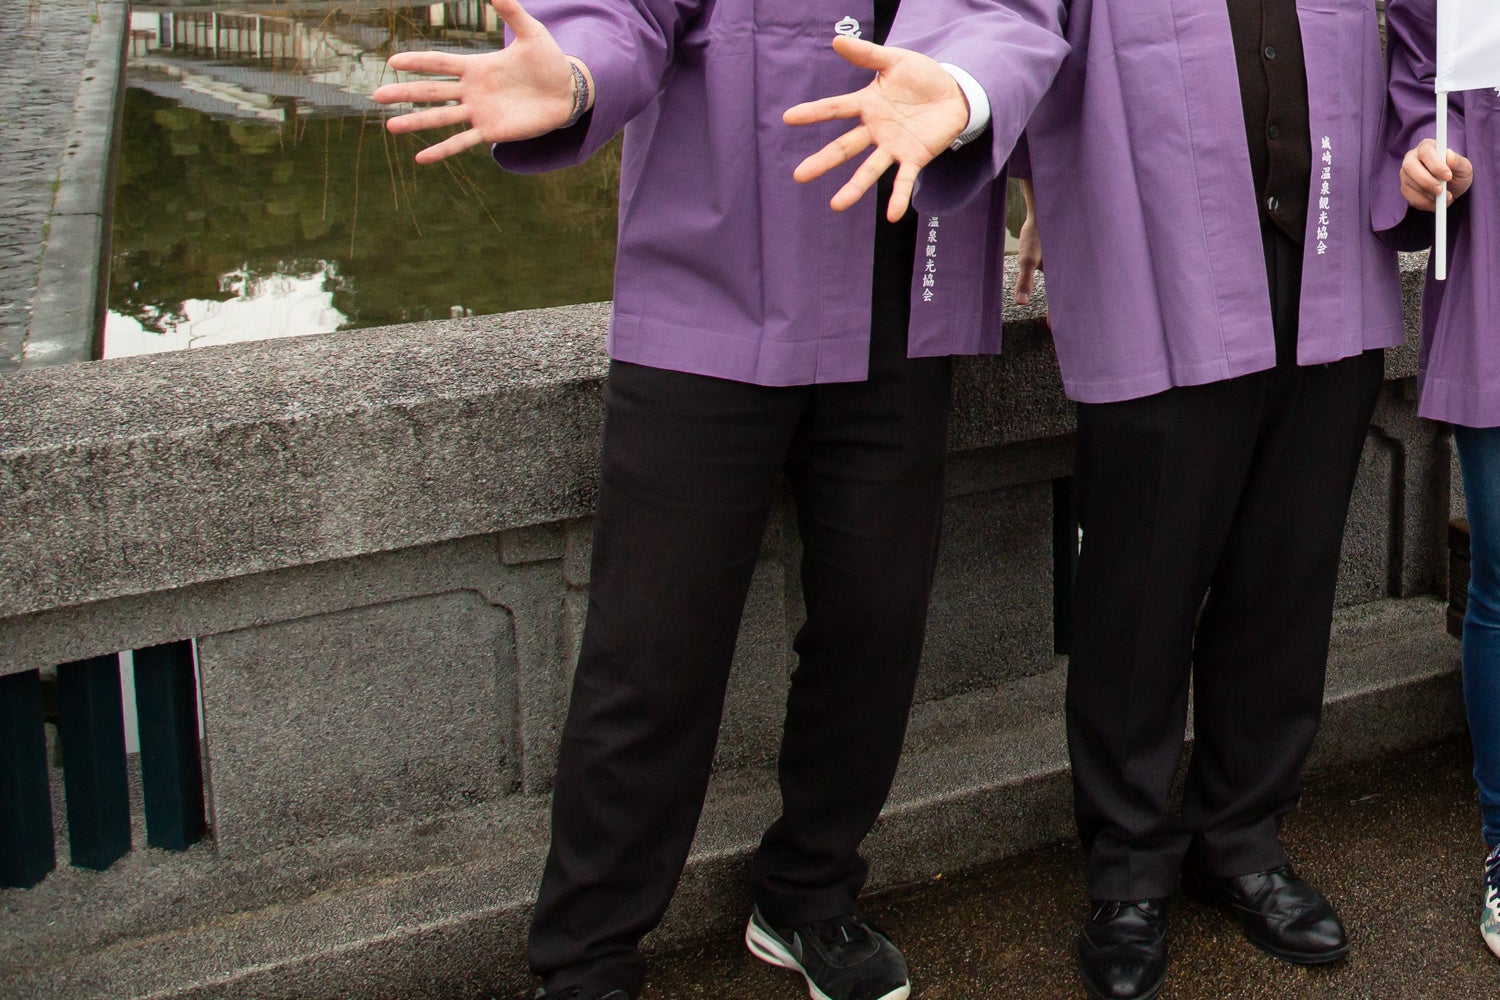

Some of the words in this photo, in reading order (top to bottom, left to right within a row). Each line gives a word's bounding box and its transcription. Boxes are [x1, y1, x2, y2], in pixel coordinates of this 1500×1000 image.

[1316, 135, 1332, 255] 城崎温泉観光協会
